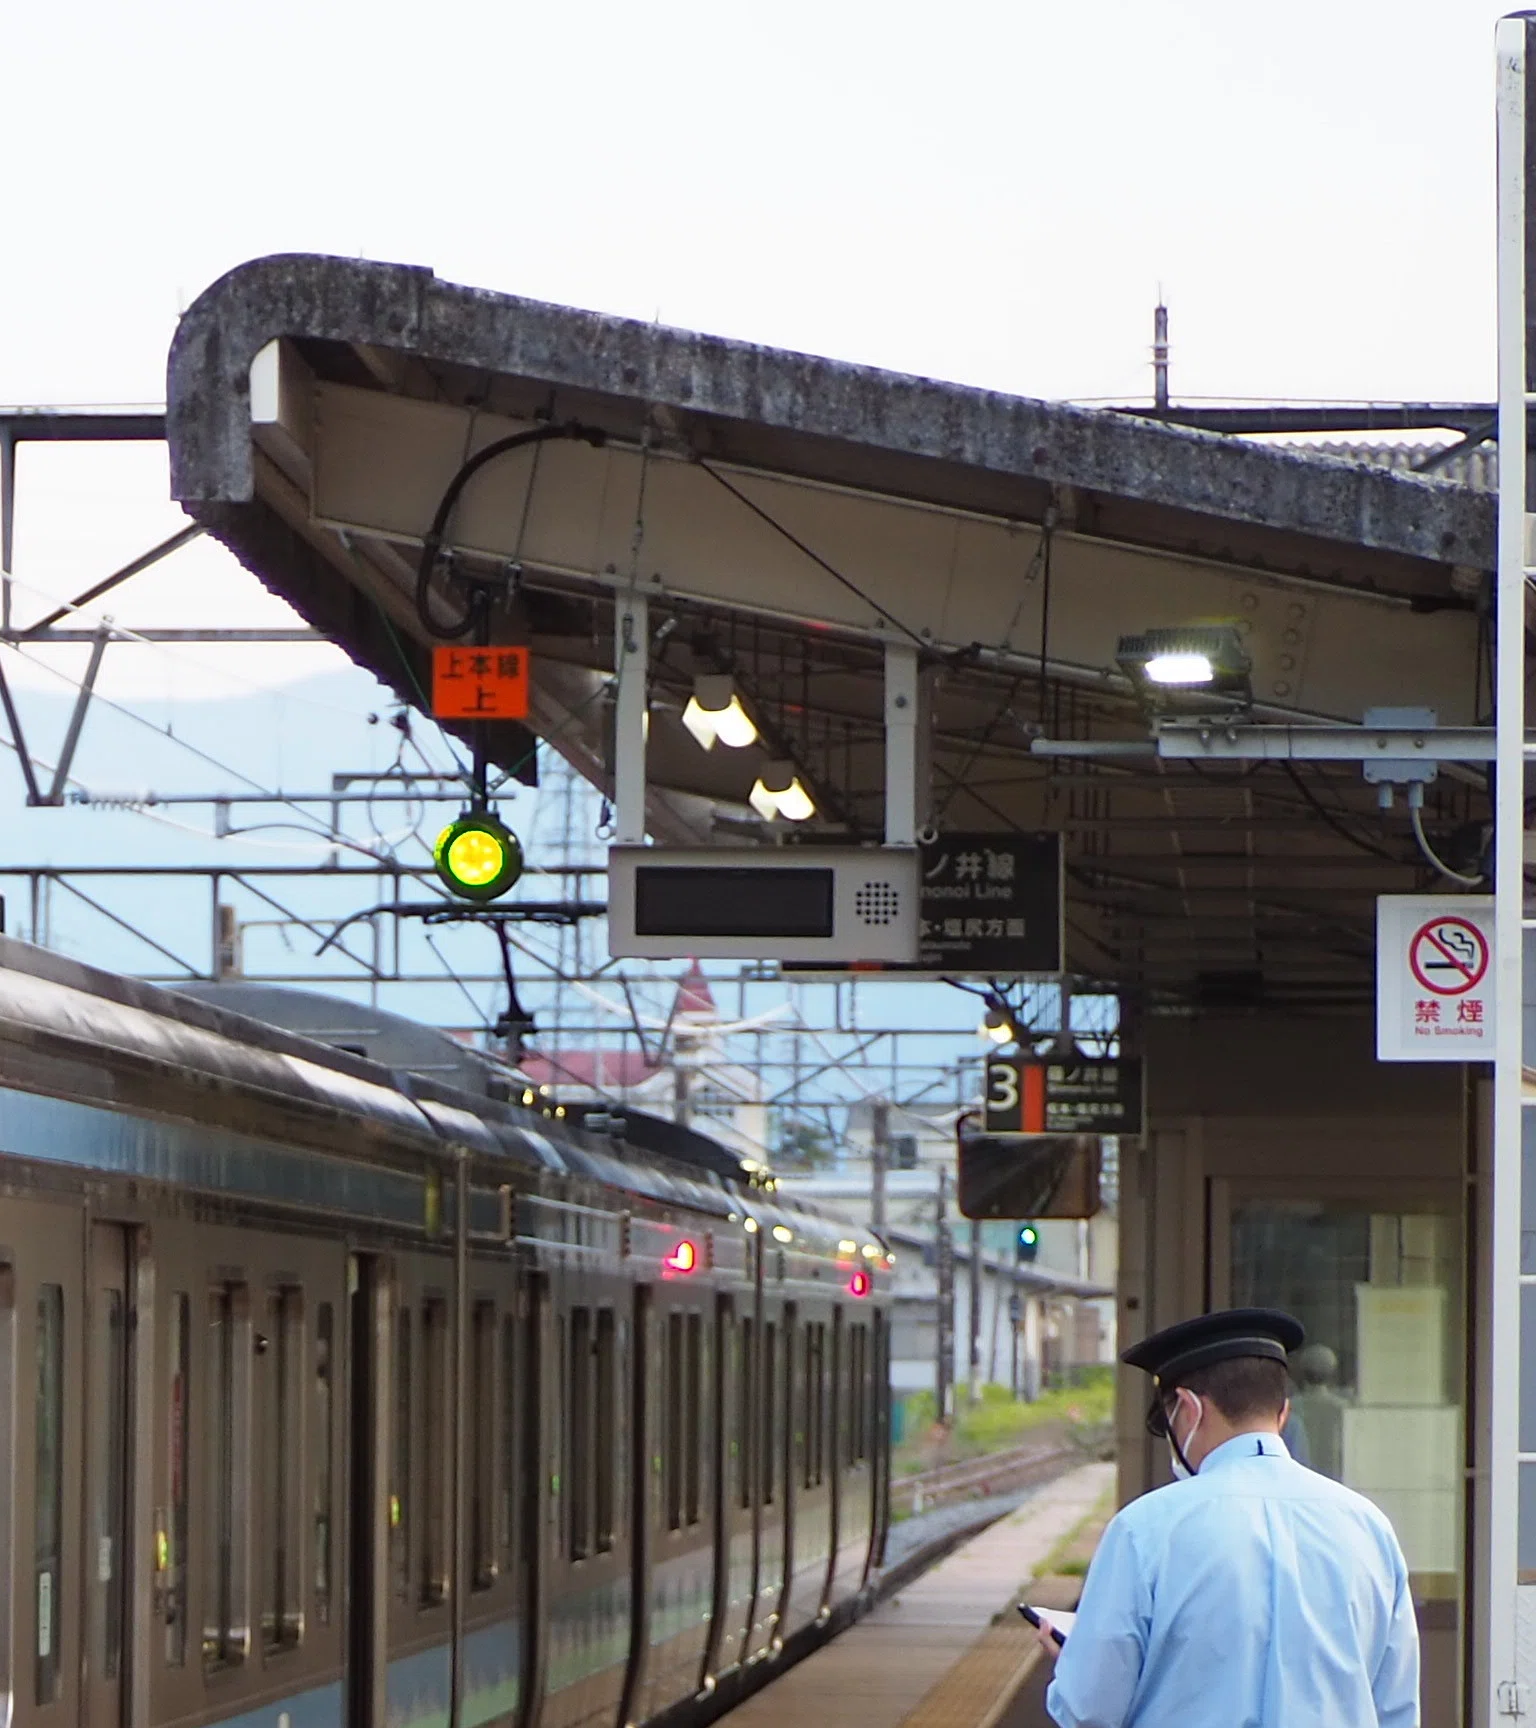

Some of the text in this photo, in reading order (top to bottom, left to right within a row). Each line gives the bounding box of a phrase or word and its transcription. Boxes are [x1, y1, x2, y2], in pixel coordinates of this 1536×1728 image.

[440, 653, 520, 679] 上本線
[462, 684, 498, 712] 上
[1415, 999, 1484, 1023] 禁煙
[1415, 1026, 1484, 1038] No Smoking
[987, 1064, 1018, 1112] 3
